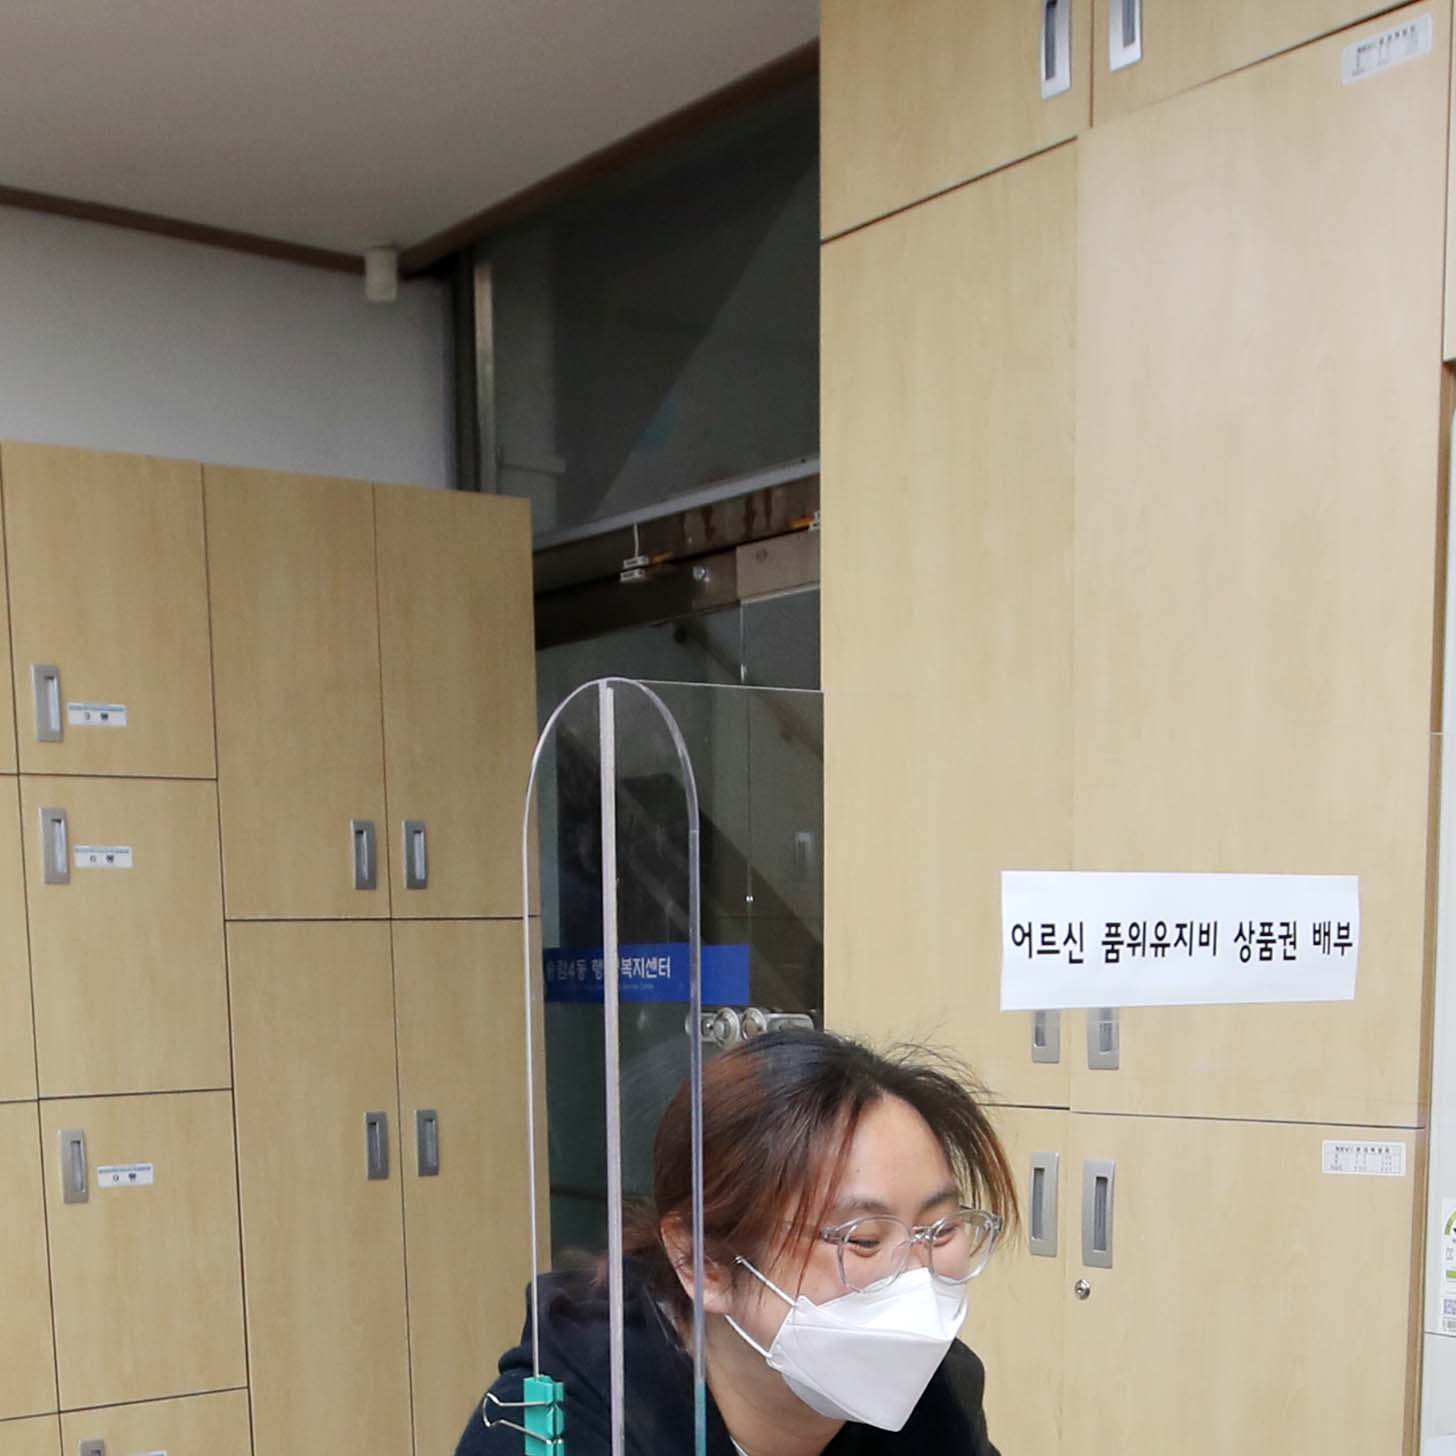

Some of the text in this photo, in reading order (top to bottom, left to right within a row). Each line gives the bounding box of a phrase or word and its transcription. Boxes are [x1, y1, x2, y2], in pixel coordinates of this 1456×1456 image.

[1011, 920, 1354, 965] 어르신 품위유지비 상품권 배부
[591, 956, 671, 981] 행복지센터
